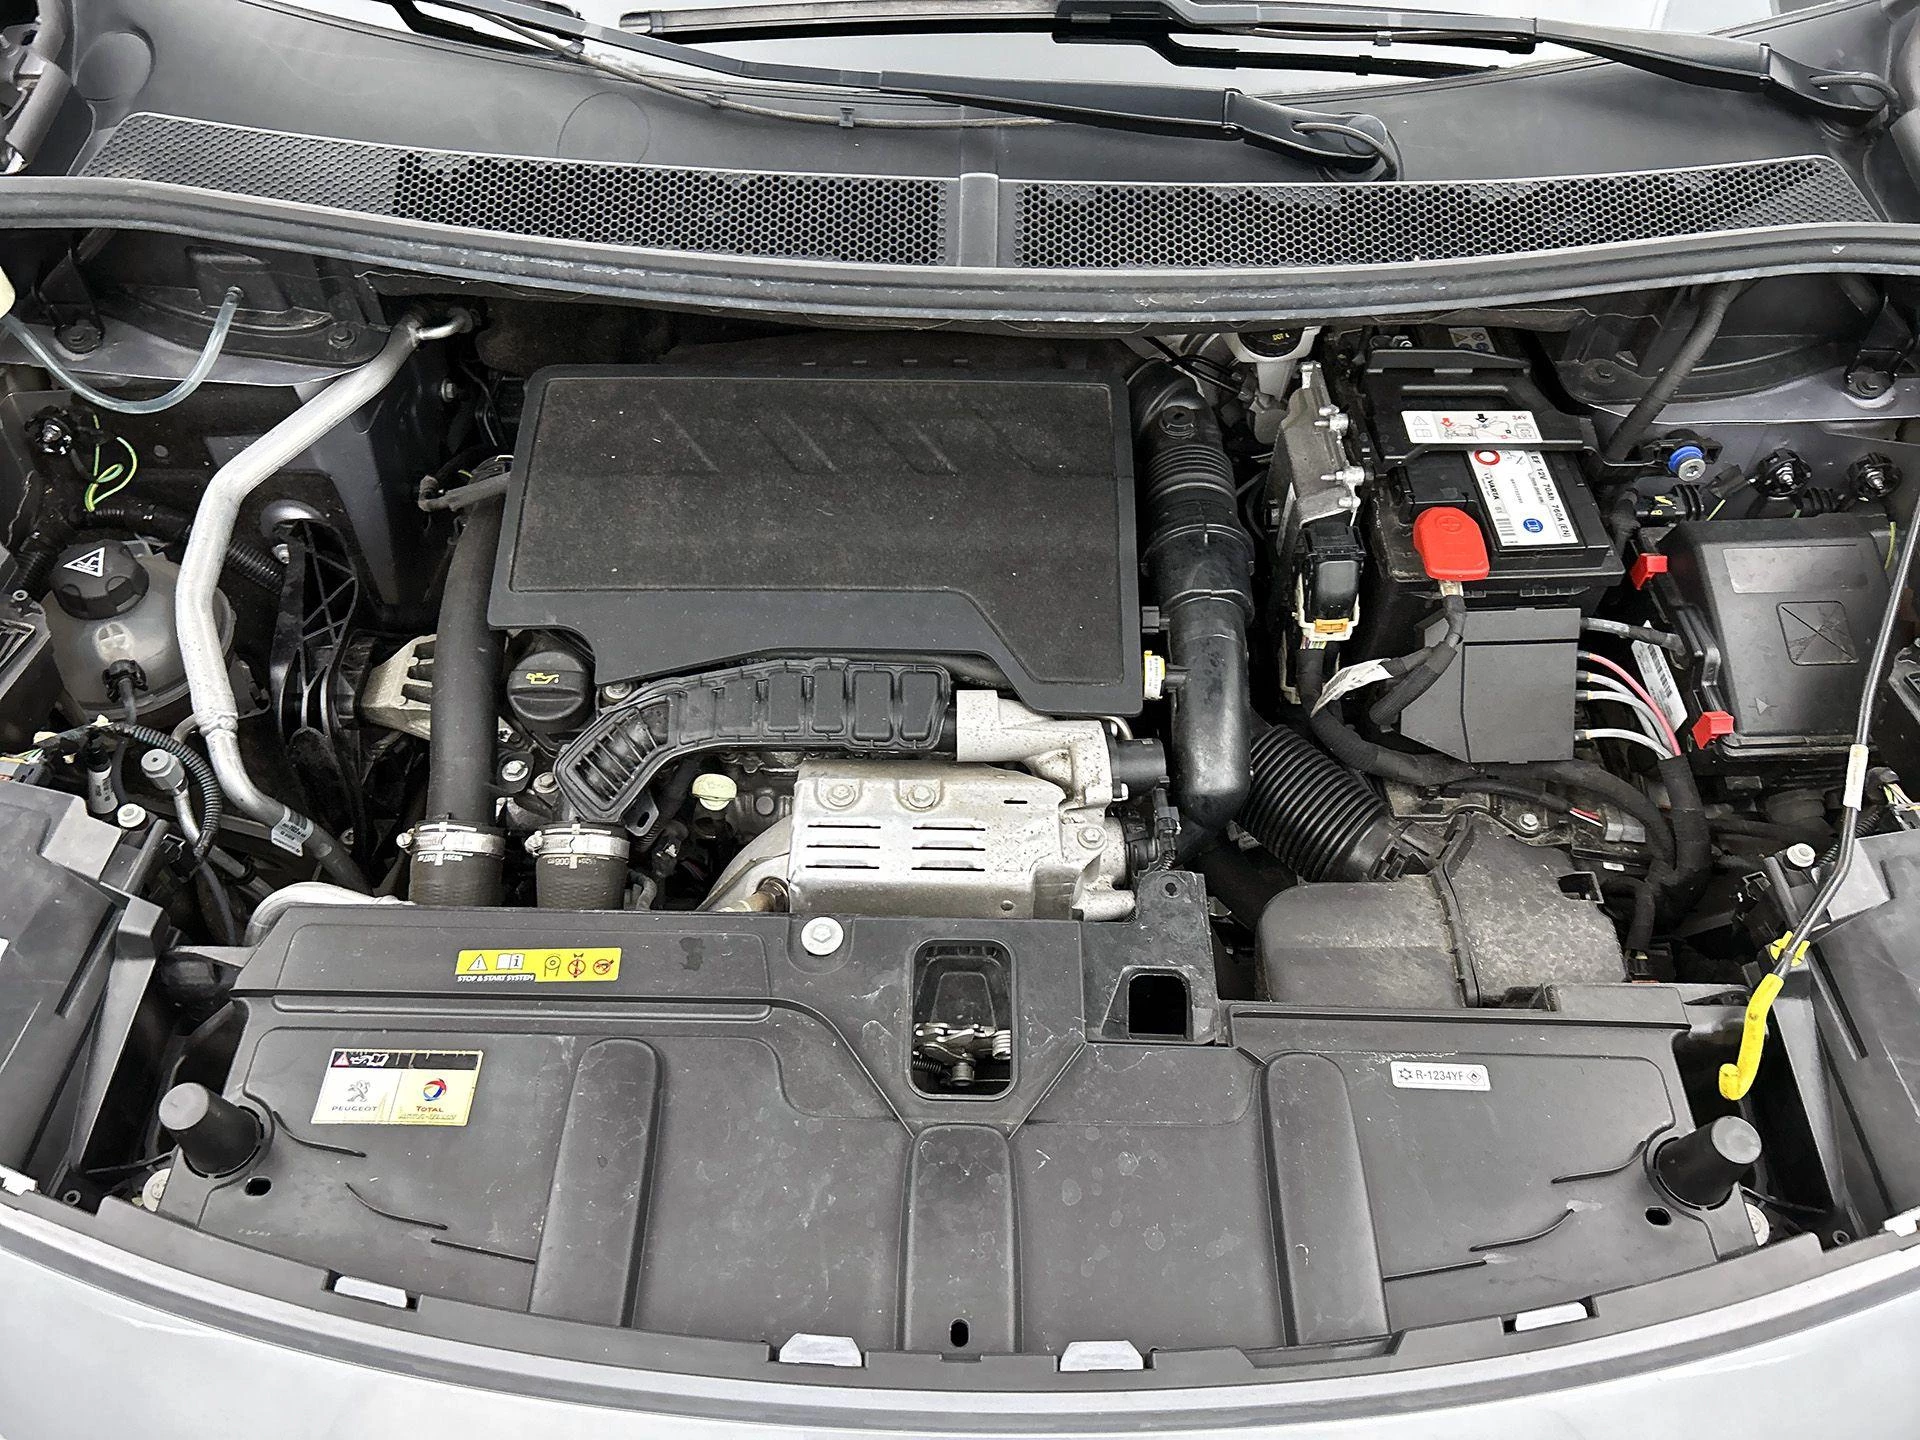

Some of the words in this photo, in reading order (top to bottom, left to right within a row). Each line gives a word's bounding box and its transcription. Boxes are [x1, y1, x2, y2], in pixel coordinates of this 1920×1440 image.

[1487, 477, 1499, 500] VARTA
[1536, 468, 1547, 480] 12V
[1543, 483, 1555, 501] 70Ah
[1551, 504, 1564, 522] 760A
[457, 974, 478, 983] STOP
[483, 974, 505, 982] START
[506, 974, 534, 982] SYSTEM
[1415, 1069, 1464, 1081] R-1234YF
[416, 1105, 444, 1113] TOTAL
